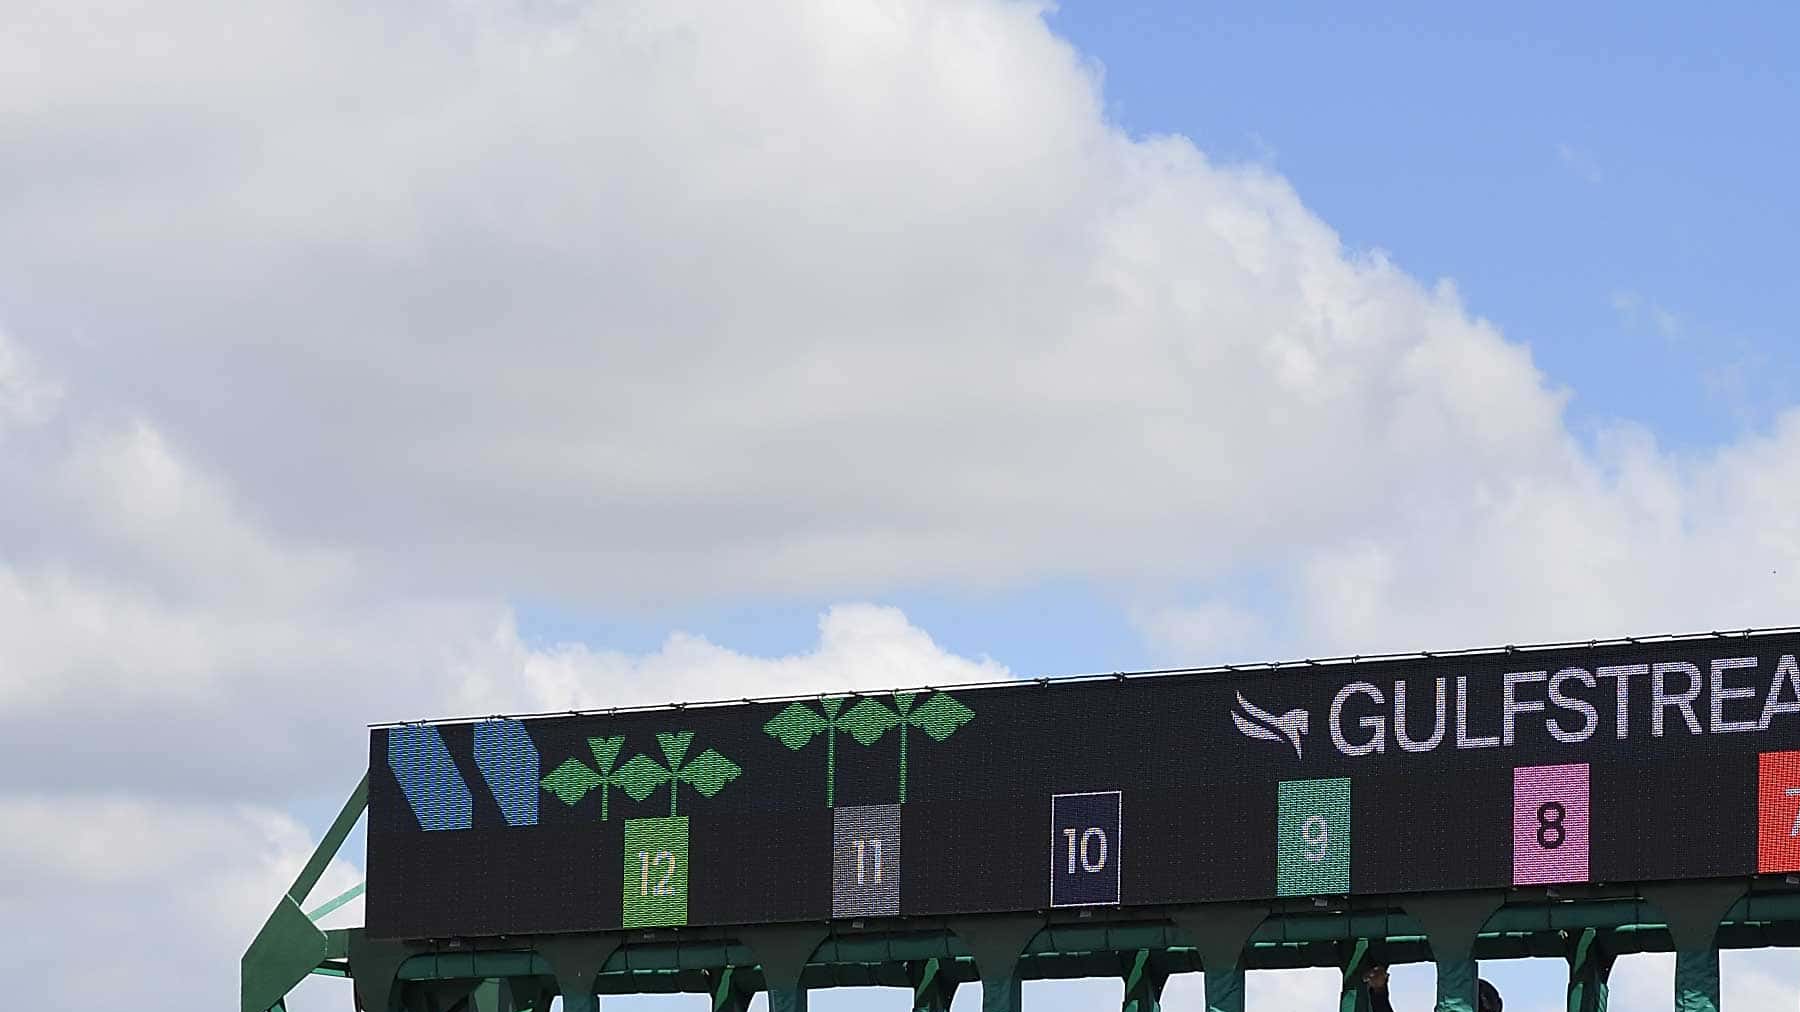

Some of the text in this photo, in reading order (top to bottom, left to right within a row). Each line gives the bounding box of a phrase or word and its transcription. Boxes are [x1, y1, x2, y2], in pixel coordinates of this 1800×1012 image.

[1301, 815, 1329, 862] 9
[1536, 800, 1566, 849] 8
[638, 849, 676, 896] 12
[851, 838, 882, 886] 11
[1063, 827, 1108, 874] 10
